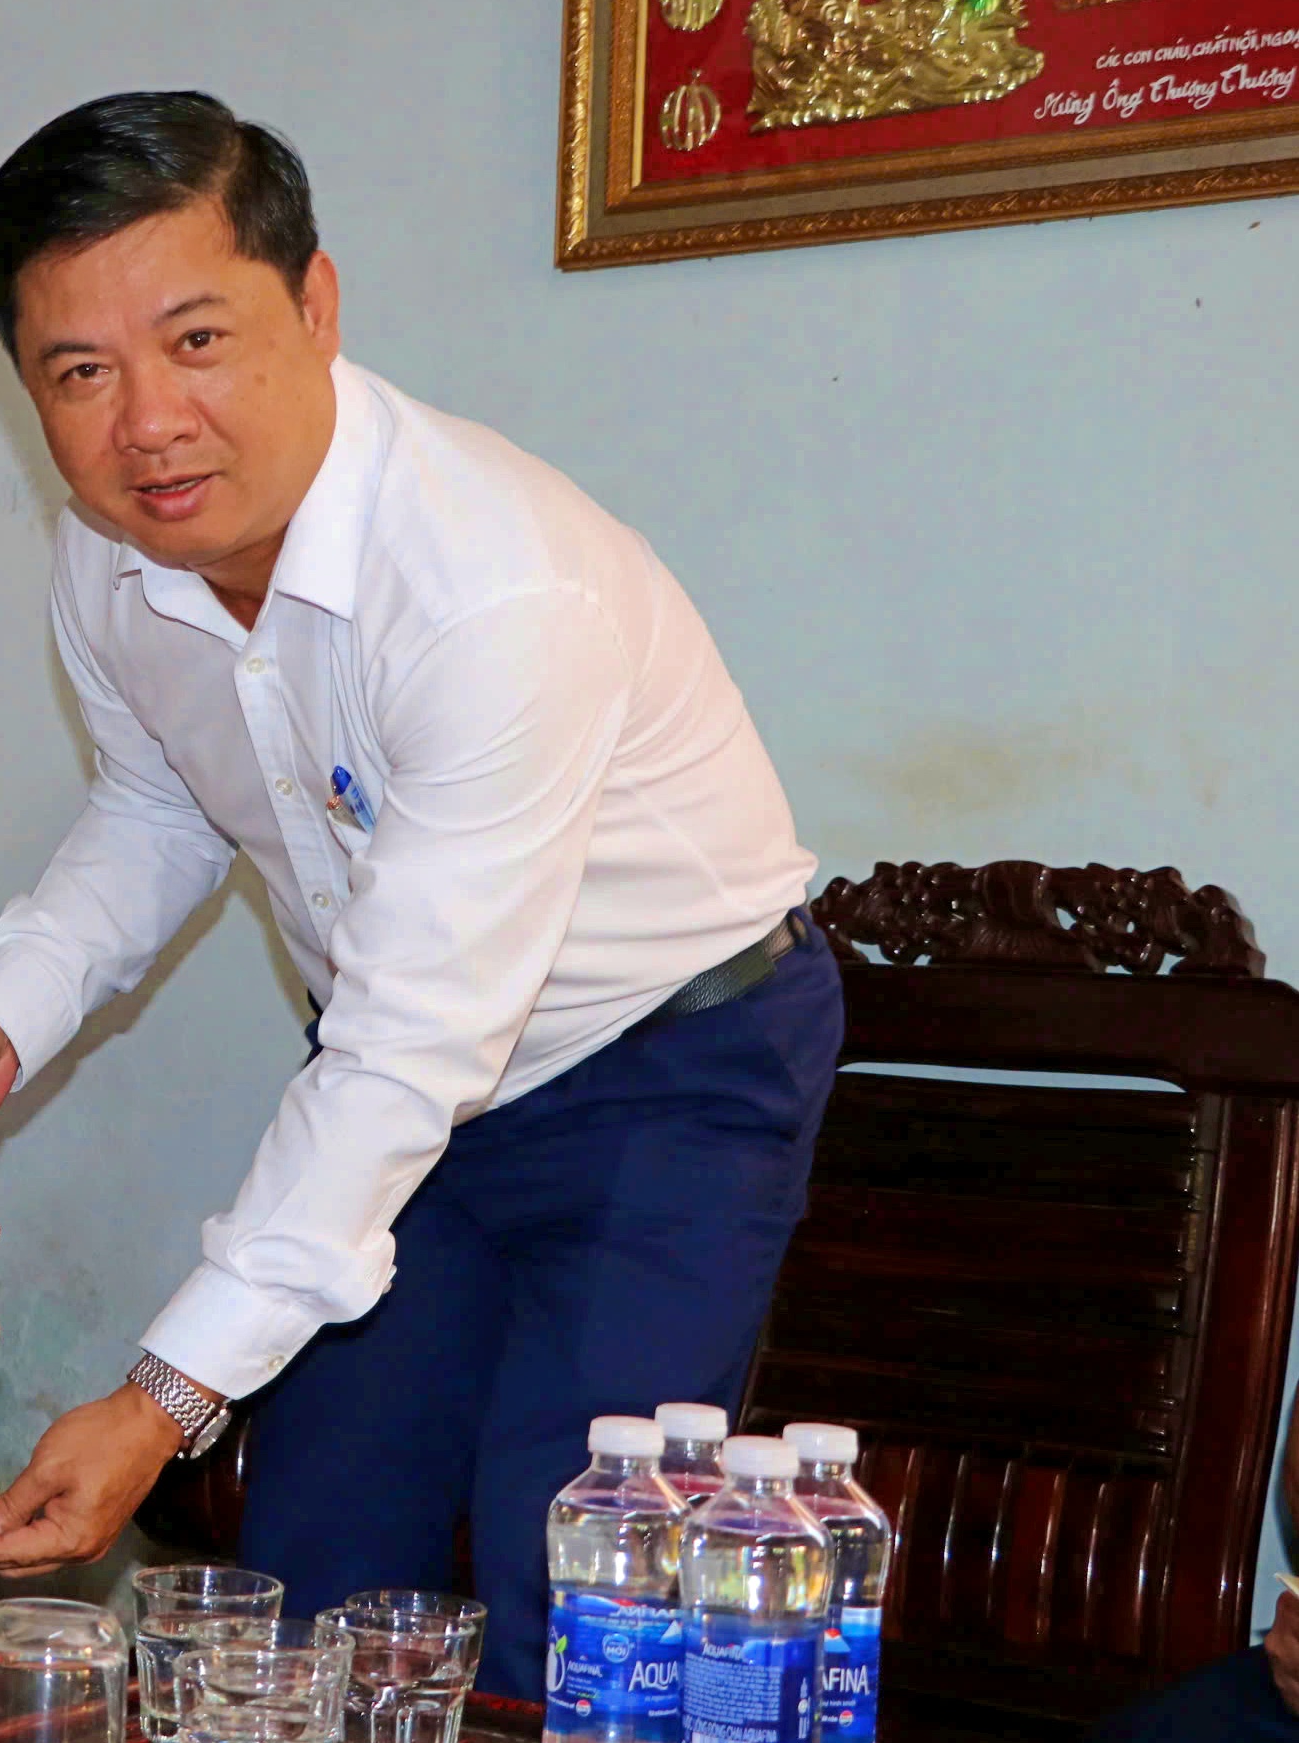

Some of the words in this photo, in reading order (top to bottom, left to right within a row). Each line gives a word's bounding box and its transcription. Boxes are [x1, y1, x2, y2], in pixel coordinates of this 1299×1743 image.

[1095, 45, 1121, 70] CÁC
[1123, 50, 1153, 66] CON
[1154, 37, 1190, 62] CHÁU,
[1034, 90, 1097, 125] Mừng
[1102, 77, 1145, 119] Ông
[1149, 74, 1219, 110] Thượng
[1220, 63, 1298, 99] Thượng
[628, 1661, 679, 1693] AQUA
